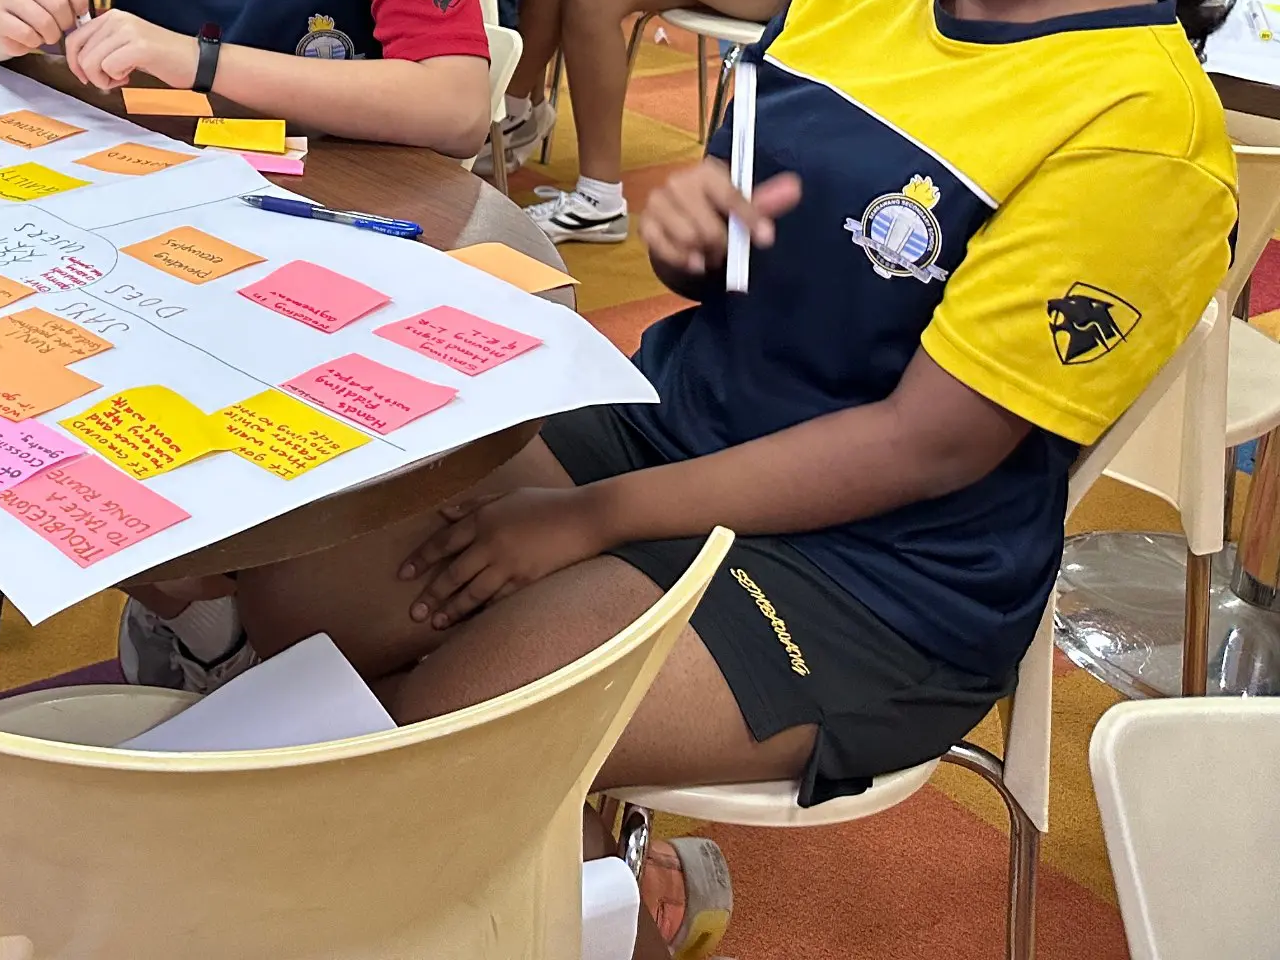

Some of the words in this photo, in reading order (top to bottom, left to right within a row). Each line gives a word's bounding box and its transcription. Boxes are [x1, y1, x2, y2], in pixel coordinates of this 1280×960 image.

[13, 223, 85, 253] USERS
[104, 285, 188, 319] DOES
[54, 302, 130, 333] SAYS
[327, 369, 373, 391] paper
[315, 375, 380, 410] fiddling
[374, 392, 410, 411] with
[85, 413, 113, 431] and
[224, 411, 265, 432] while
[232, 405, 256, 417] the
[258, 417, 273, 426] to
[338, 402, 387, 428] Hands
[72, 421, 129, 459] GROUND
[226, 425, 264, 446] walk
[270, 433, 317, 461] faster
[277, 424, 330, 455] moving
[309, 430, 340, 450] side
[269, 445, 306, 469] then
[268, 463, 294, 477] If
[45, 469, 102, 502] ROUTE
[45, 492, 67, 502] A
[59, 502, 108, 533] TAKE
[99, 500, 151, 534] LONG
[106, 532, 128, 546] TO
